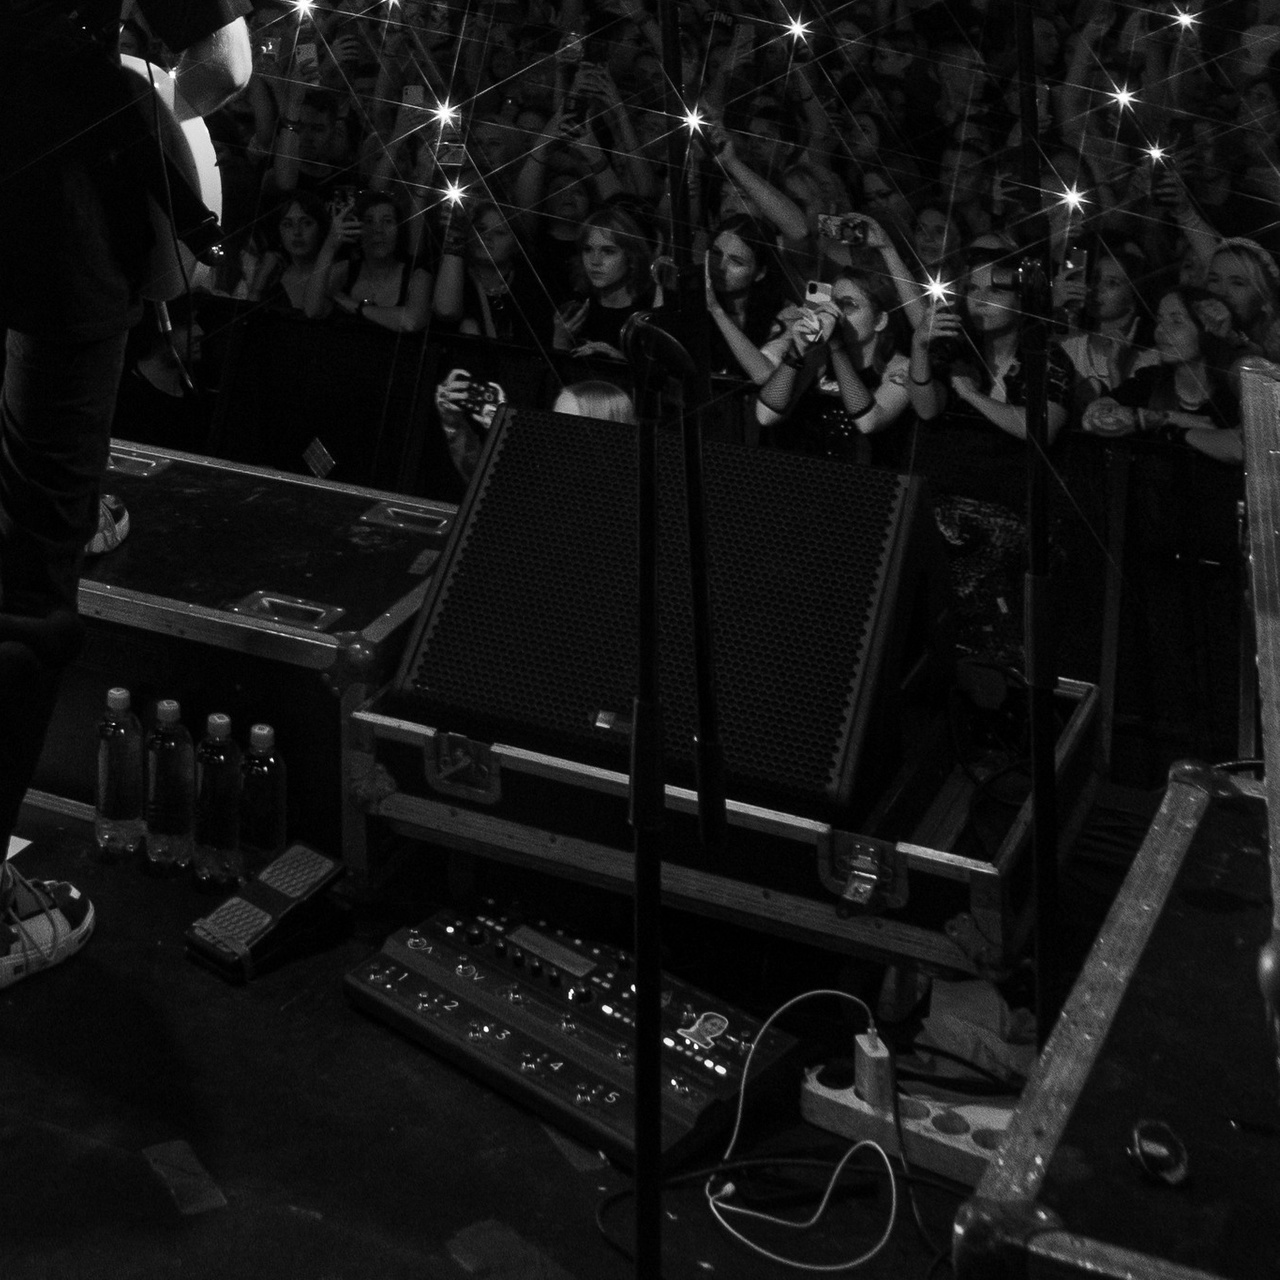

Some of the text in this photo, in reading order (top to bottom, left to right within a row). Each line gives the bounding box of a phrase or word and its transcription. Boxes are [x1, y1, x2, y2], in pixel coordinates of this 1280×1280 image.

[398, 972, 409, 981] 1
[443, 1000, 459, 1011] 2
[495, 1029, 511, 1040] 3
[549, 1061, 564, 1071] 4
[604, 1091, 620, 1103] 5
